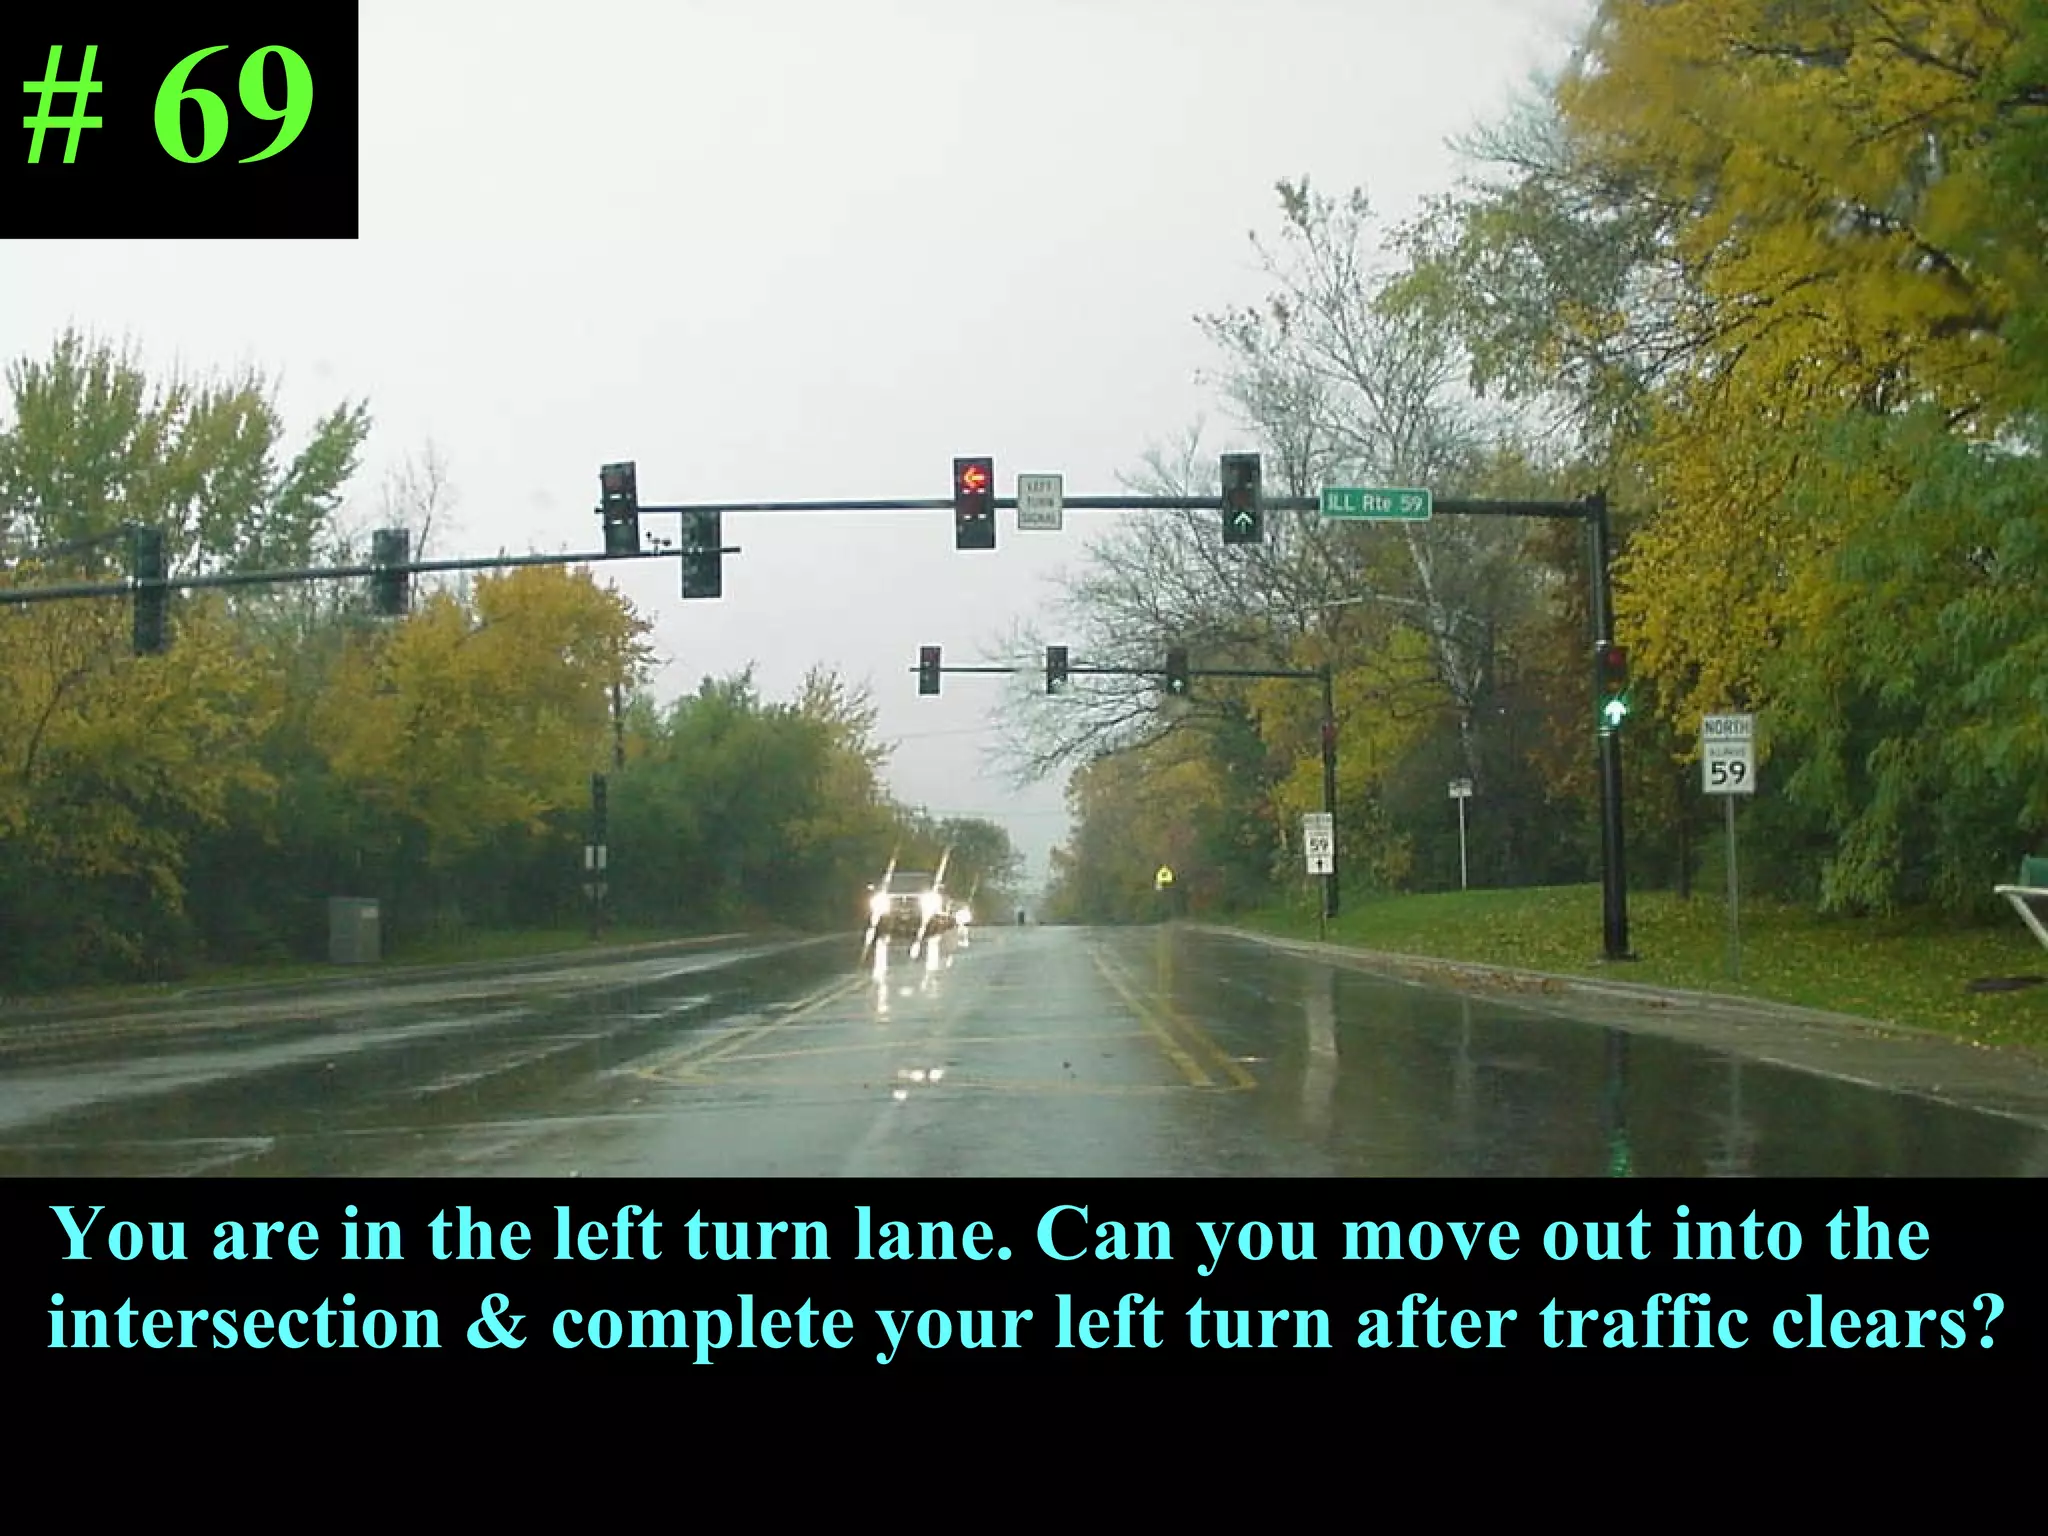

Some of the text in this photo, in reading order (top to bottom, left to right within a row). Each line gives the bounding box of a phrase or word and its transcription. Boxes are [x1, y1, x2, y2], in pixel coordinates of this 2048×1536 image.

[1328, 492, 1356, 511] ILL
[1401, 494, 1423, 511] 59
[1705, 719, 1748, 735] NORTH
[1711, 761, 1746, 785] 59
